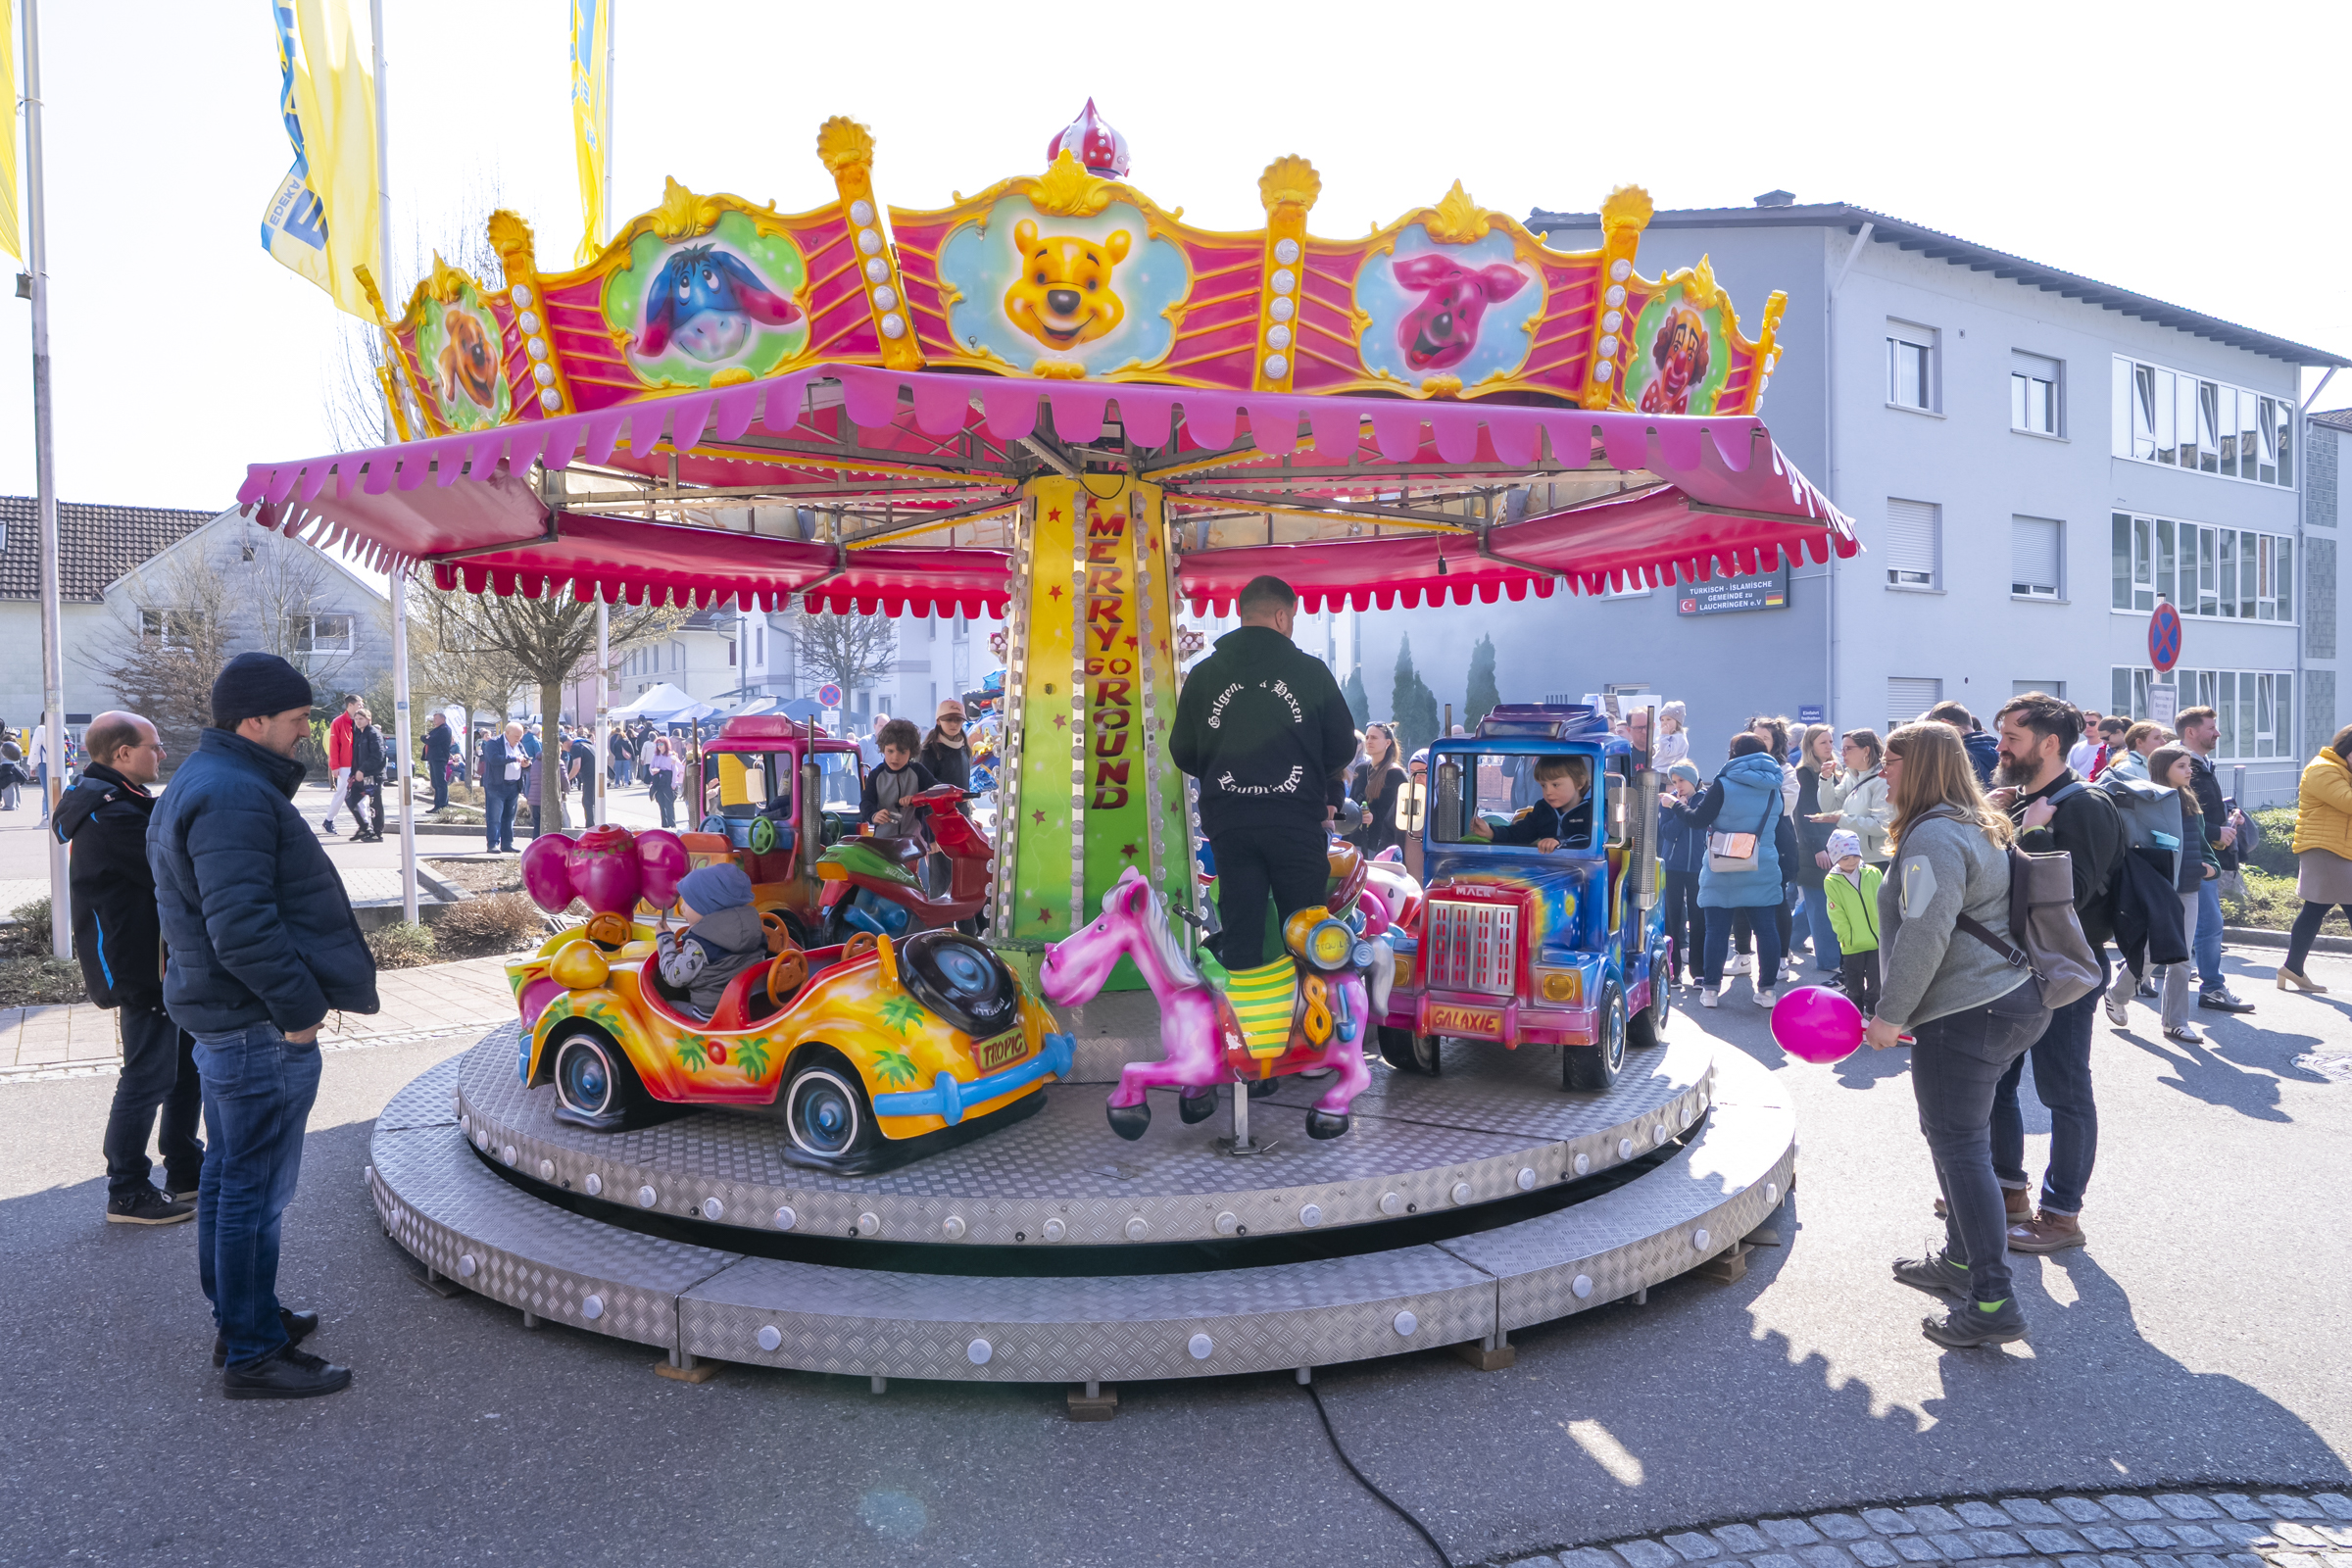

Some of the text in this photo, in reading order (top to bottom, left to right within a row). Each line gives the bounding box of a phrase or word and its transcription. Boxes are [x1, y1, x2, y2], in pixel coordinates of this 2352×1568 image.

[270, 179, 300, 226] EDEKA
[1085, 513, 1132, 809] MERRY GO ROUND
[1271, 679, 1302, 723] Hexen
[884, 866, 907, 882] SUZUKI
[1456, 887, 1492, 898] MACK
[975, 997, 1005, 1016] PIRELLI
[1434, 1010, 1498, 1032] GALAXIE
[984, 1032, 1022, 1066] TROPIC
